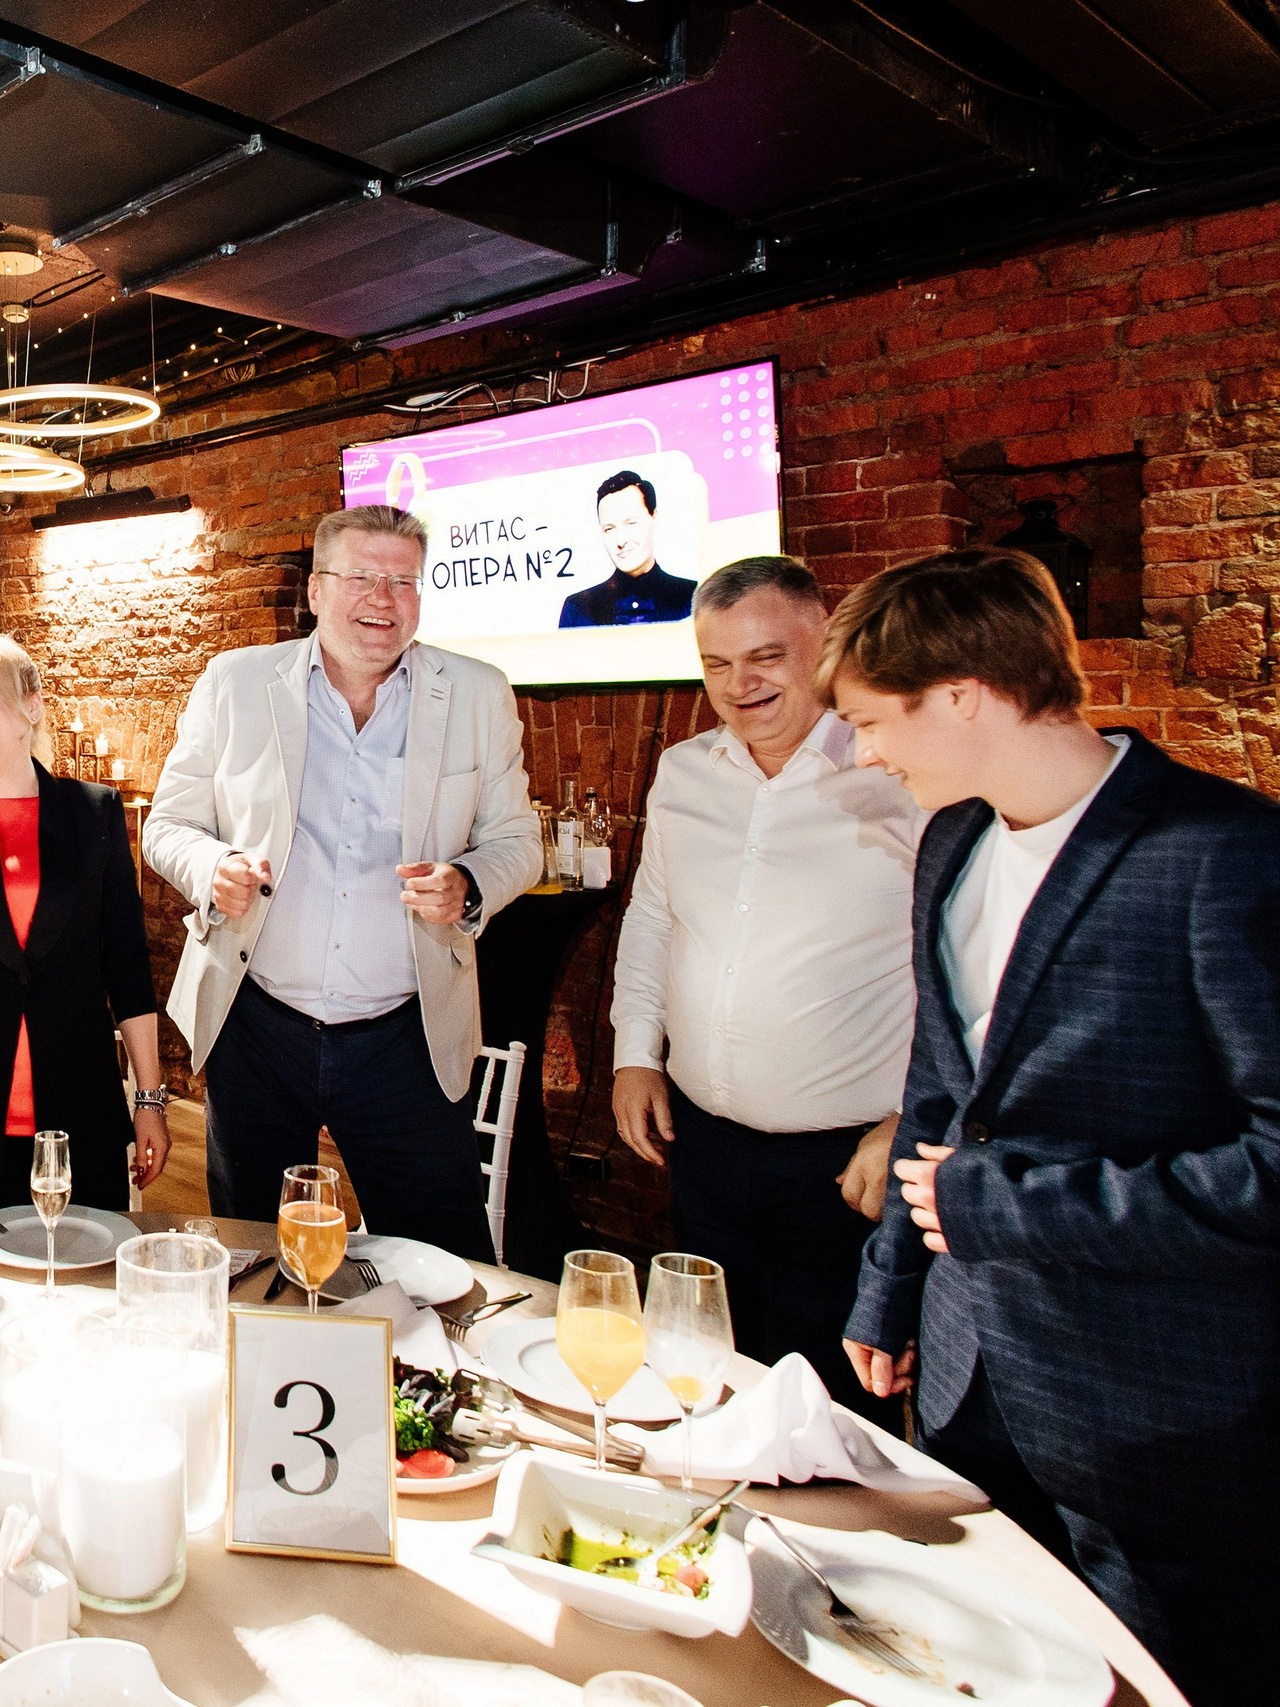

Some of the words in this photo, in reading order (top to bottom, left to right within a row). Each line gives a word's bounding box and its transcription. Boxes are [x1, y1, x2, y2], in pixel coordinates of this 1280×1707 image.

[450, 516, 526, 548] ВИТАС
[432, 554, 517, 589] ОПЕРА
[526, 548, 574, 580] №2
[270, 1380, 339, 1496] 3
